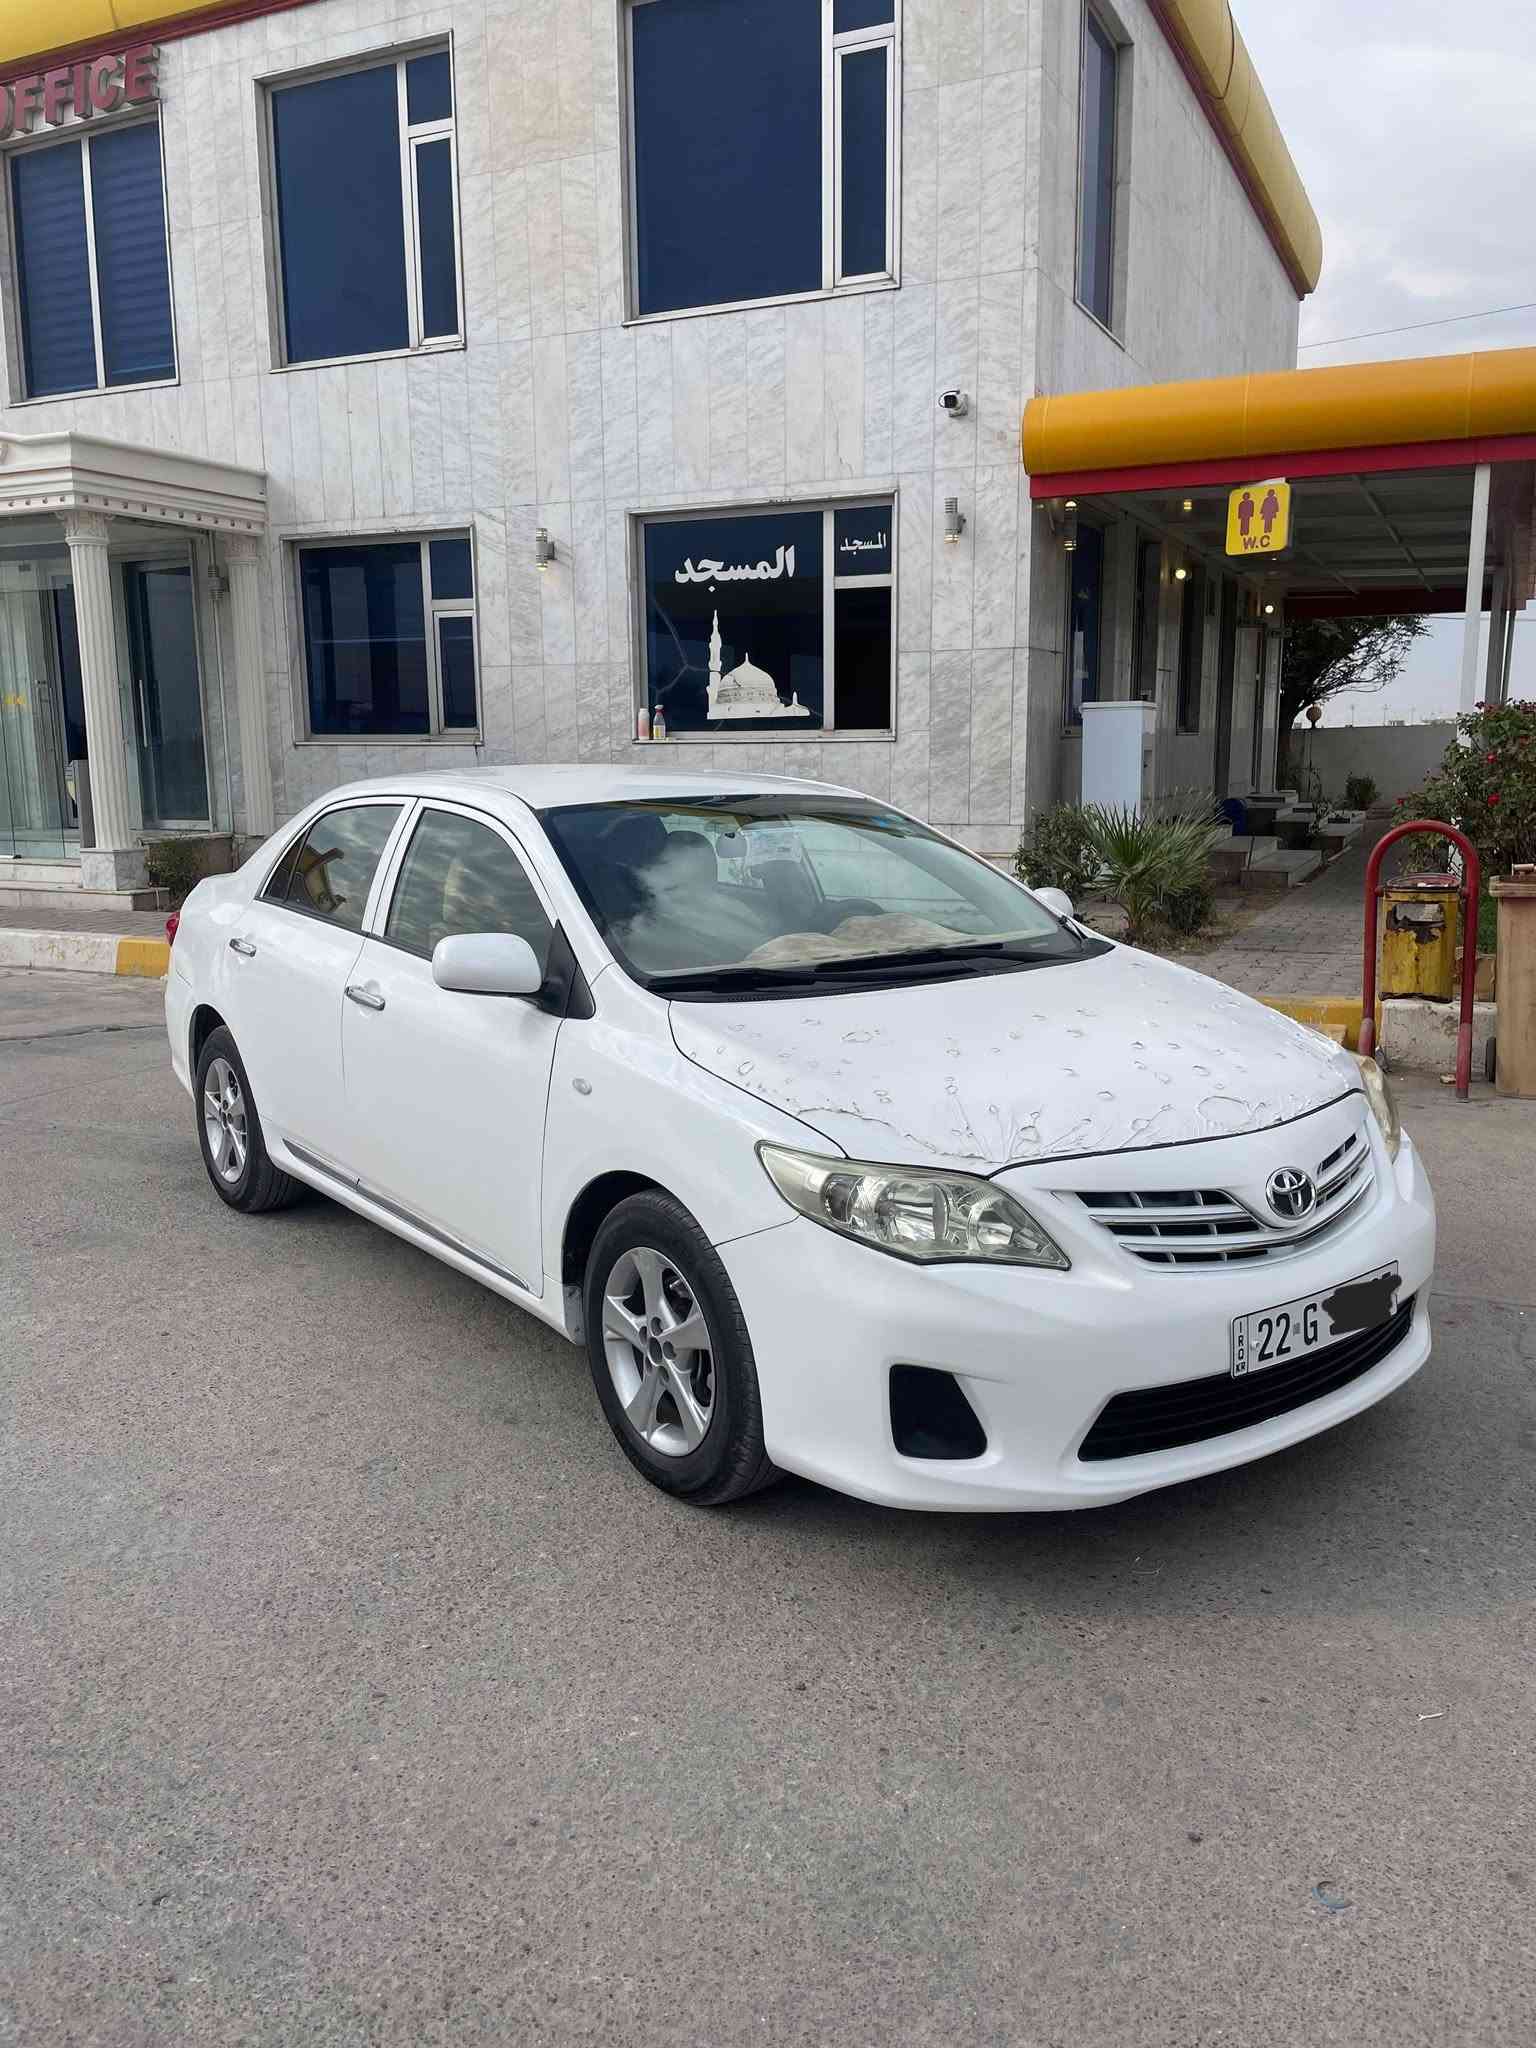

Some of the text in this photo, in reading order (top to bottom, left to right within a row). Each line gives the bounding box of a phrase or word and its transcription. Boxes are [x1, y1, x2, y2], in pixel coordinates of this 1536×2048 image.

[1243, 534, 1270, 550] W.C
[675, 544, 795, 593] المسجد
[1258, 1312, 1291, 1362] 22
[1303, 1302, 1318, 1346] G
